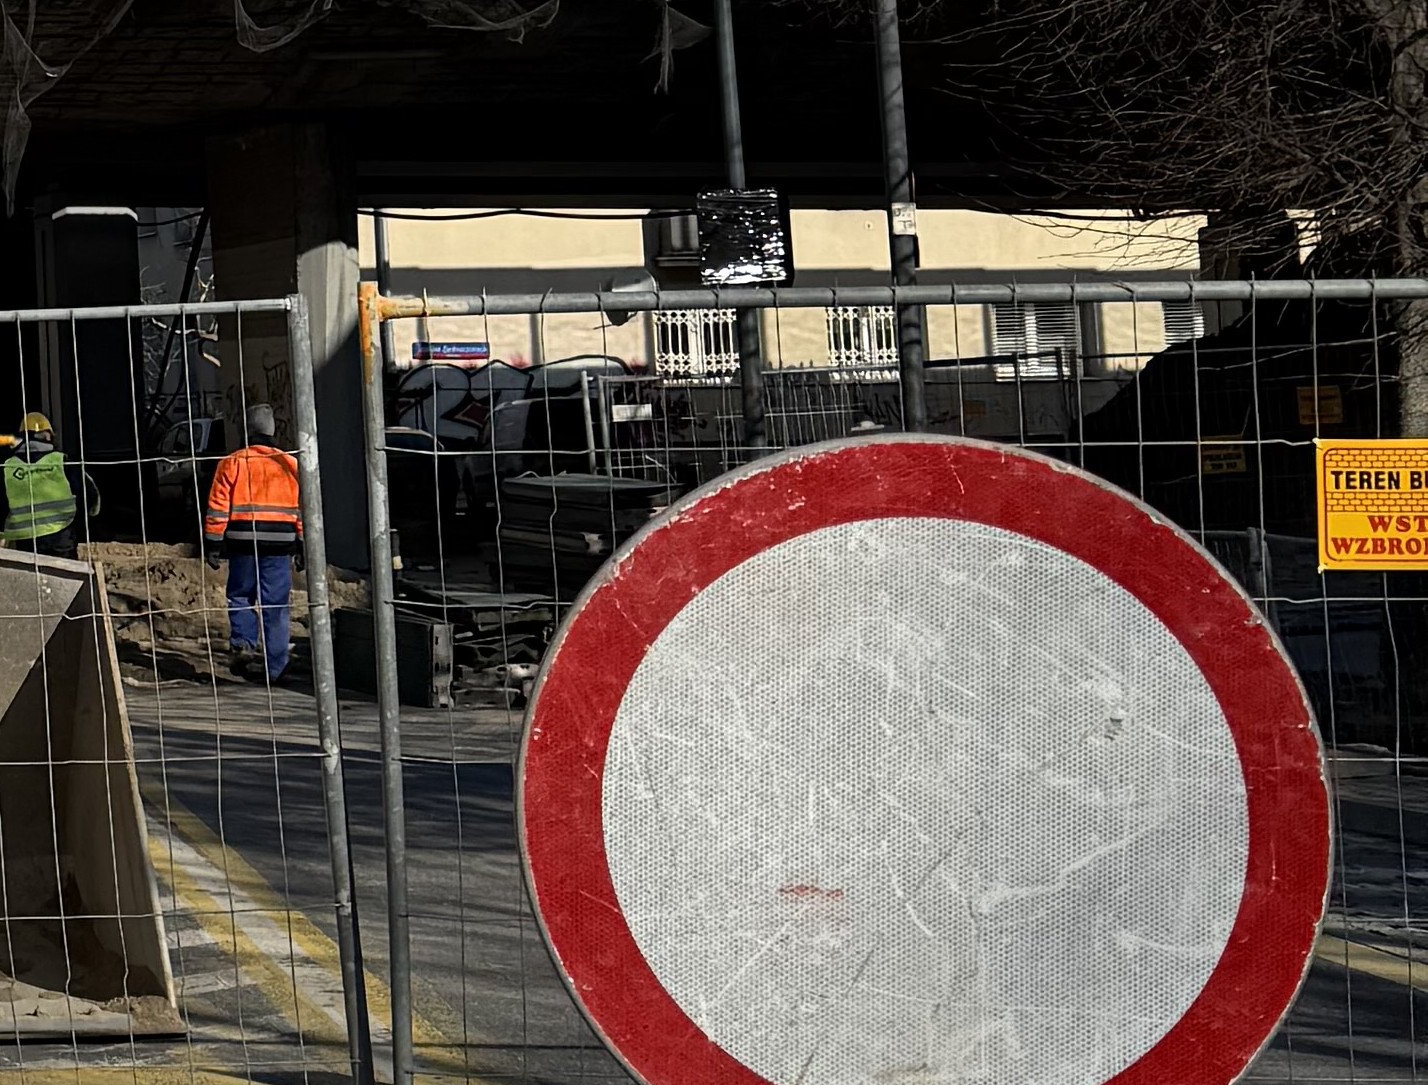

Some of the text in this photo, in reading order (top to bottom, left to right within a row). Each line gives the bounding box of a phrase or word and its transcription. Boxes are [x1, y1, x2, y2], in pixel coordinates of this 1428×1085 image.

[1330, 470, 1428, 490] TEREN B
[1366, 515, 1428, 533] WST
[1331, 537, 1428, 555] WZBRO
